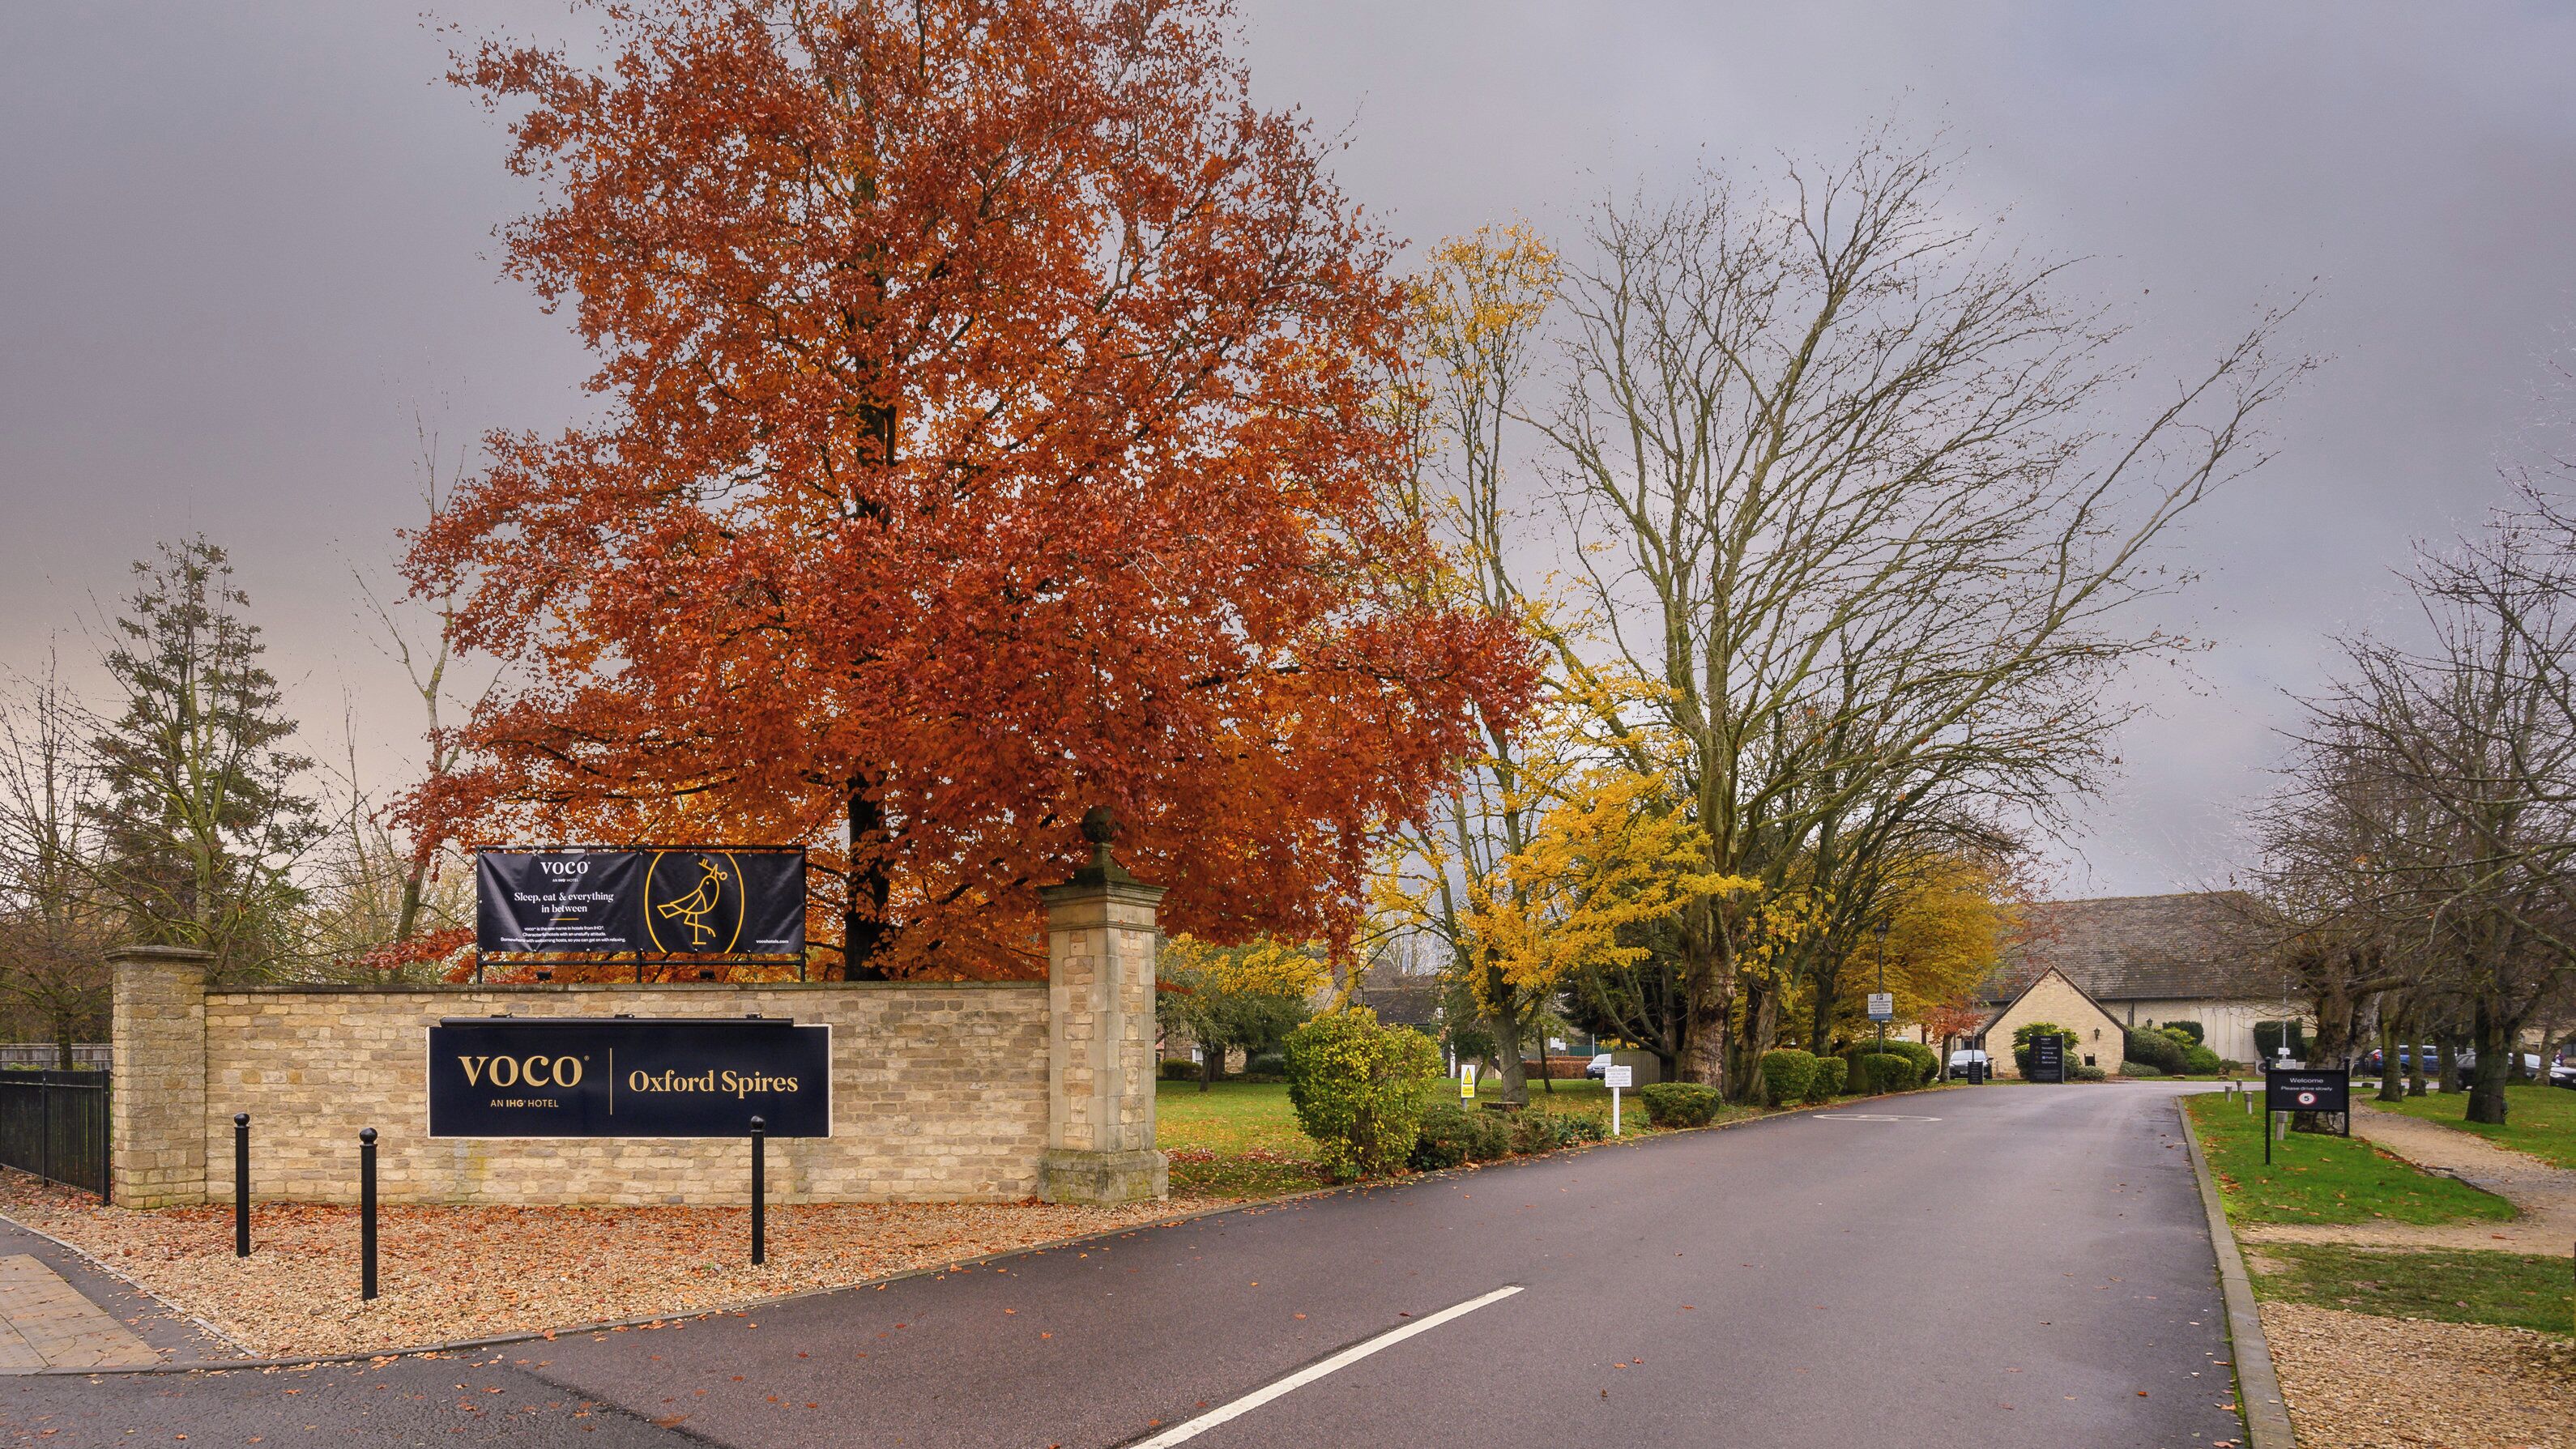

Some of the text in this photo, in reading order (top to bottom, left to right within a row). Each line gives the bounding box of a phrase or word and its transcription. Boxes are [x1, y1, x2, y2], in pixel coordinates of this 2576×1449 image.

[514, 892, 614, 903] Sleep, eat & everything
[541, 904, 587, 913] in between
[629, 1069, 799, 1099] Oxford Spires
[490, 1099, 504, 1107] AN
[528, 1099, 559, 1107] HOTEL
